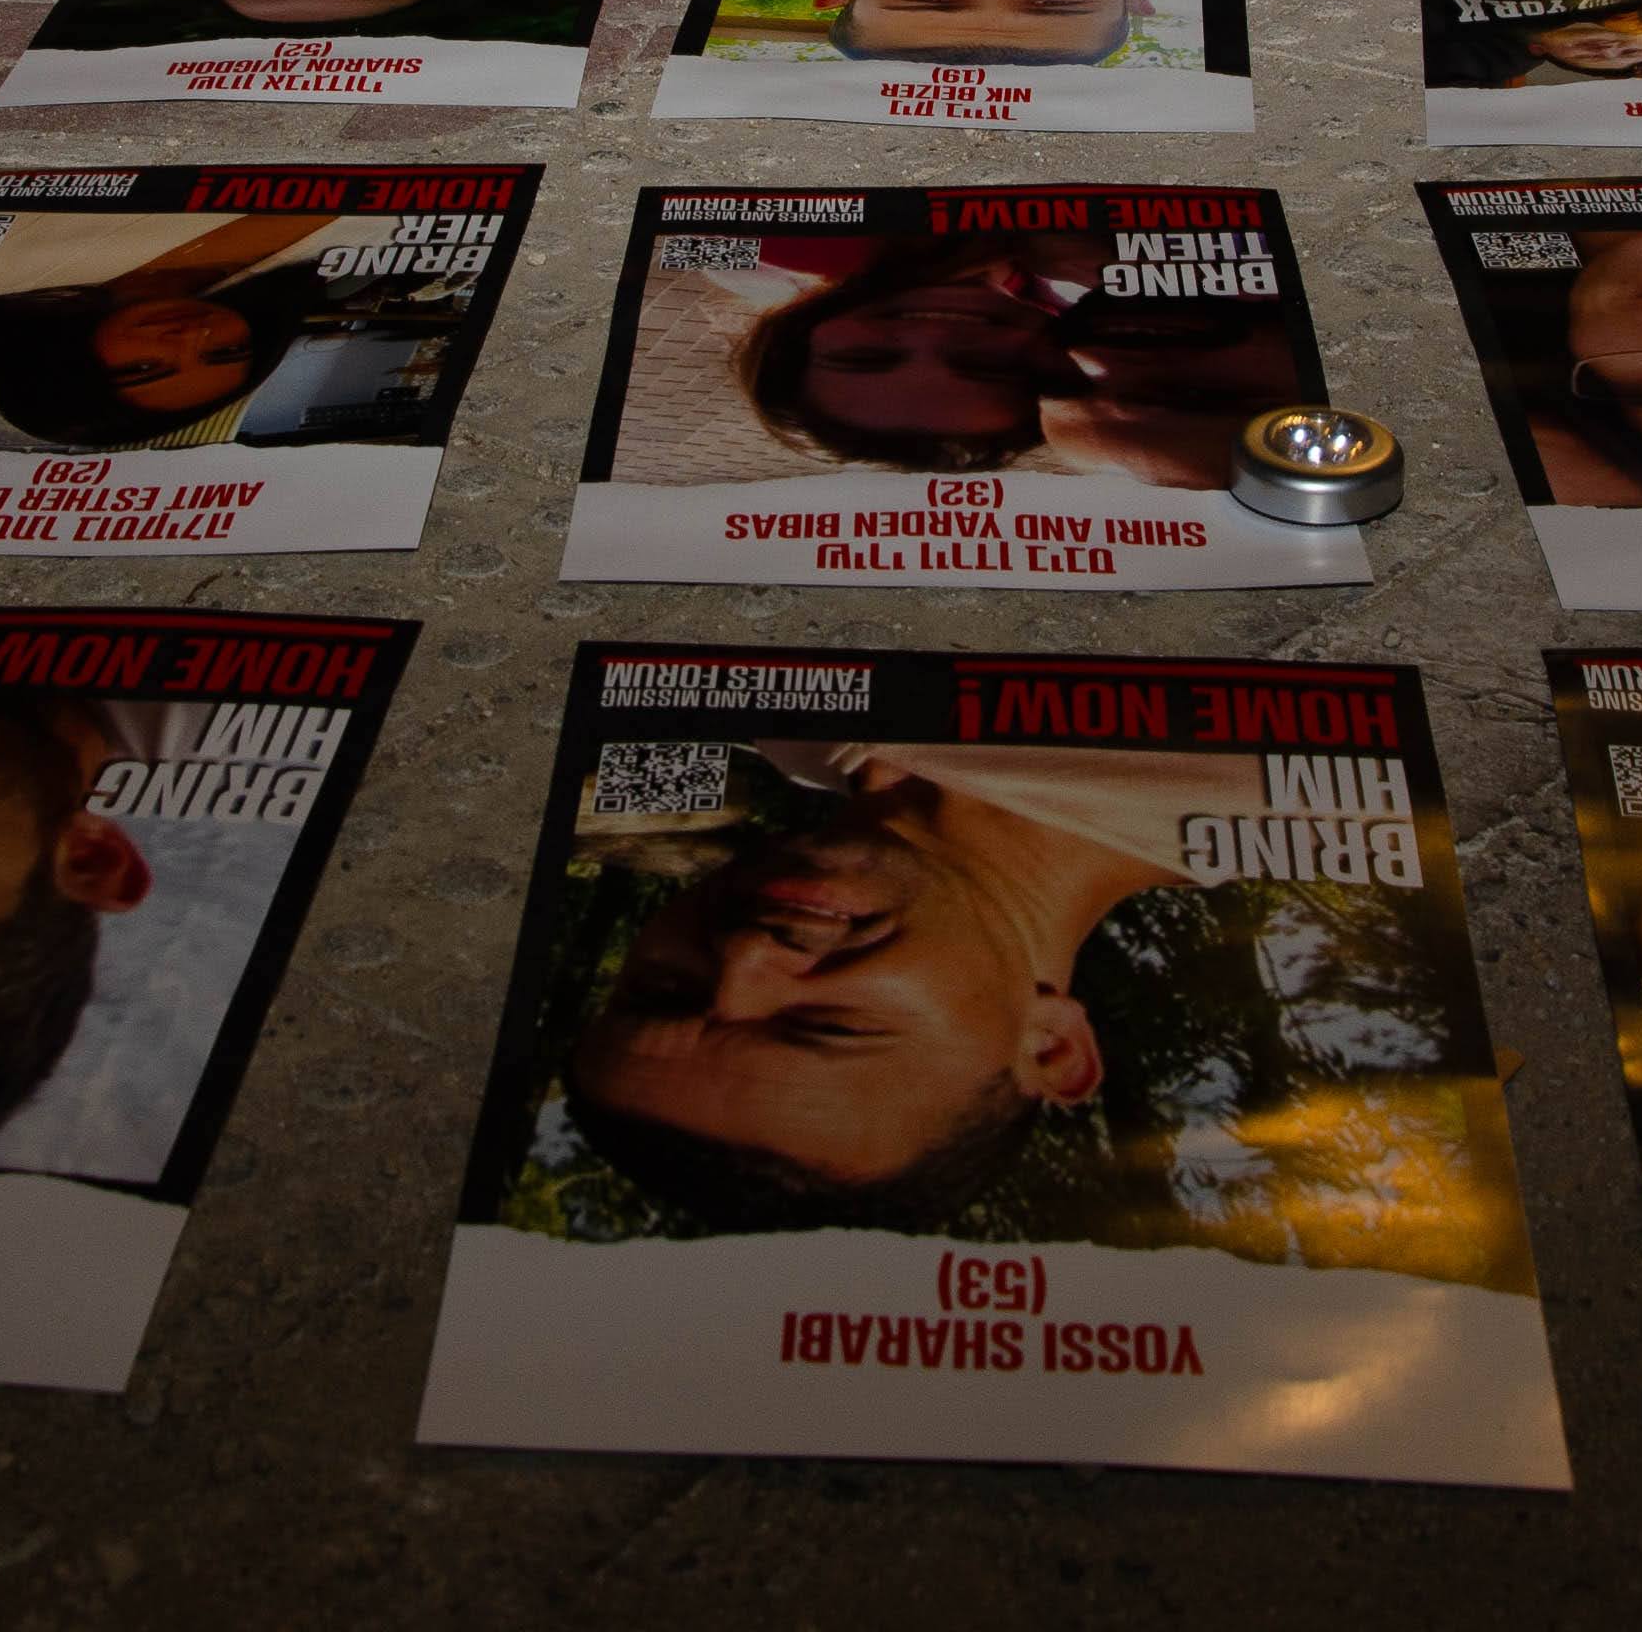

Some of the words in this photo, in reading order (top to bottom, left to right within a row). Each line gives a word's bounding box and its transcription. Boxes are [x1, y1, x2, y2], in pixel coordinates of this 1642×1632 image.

[274, 41, 333, 58] (52)
[165, 58, 300, 76] AVIGDORI
[304, 57, 424, 75] SHARON
[931, 67, 986, 85] (19)
[880, 84, 976, 102] BEIZER
[987, 87, 1033, 103] NIK
[890, 99, 934, 119] ניק
[947, 103, 1017, 120] בייזר
[185, 174, 348, 211] NOW!
[362, 176, 516, 211] HOME
[660, 195, 751, 212] FORUM
[757, 196, 865, 212] FAMILIES
[1447, 187, 1536, 205] FORUM
[660, 210, 733, 223] MISSING
[737, 210, 774, 223] AND
[778, 210, 864, 223] HOSTAGES
[928, 196, 1088, 234] NOW!
[1105, 194, 1261, 230] HOME
[1451, 200, 1529, 216] MISSING
[1532, 200, 1568, 216] AND
[392, 213, 505, 244] HER
[318, 244, 489, 277] BRING
[1116, 231, 1273, 263] THEM
[1102, 262, 1280, 298] BRING
[32, 459, 112, 486] (28)
[21, 487, 155, 510] ESTHER
[165, 483, 263, 510] AMIT
[926, 478, 1006, 509] (32)
[73, 513, 237, 541] בוסקילה
[726, 513, 840, 540] BIBAS
[851, 511, 1005, 540] YARDEN
[1014, 515, 1090, 544] AND
[1105, 519, 1206, 548] SHIRI
[817, 544, 905, 571] שירי
[921, 538, 1012, 573] וירדן
[1026, 546, 1115, 575] ביבס
[166, 636, 375, 694] HOME
[603, 662, 720, 690] FORUM
[725, 665, 872, 692] FAMILIES
[600, 686, 699, 710] MISSING
[703, 687, 751, 711] AND
[754, 689, 871, 712] HOSTAGES
[953, 677, 1167, 740] NOW!
[1191, 682, 1397, 747] HOME
[194, 702, 352, 759] HIM
[86, 760, 326, 824] BRING
[1264, 752, 1410, 813] HIM
[1182, 816, 1422, 889] BRING
[937, 1253, 1047, 1314] (53)
[780, 1314, 1023, 1369] SHARABI
[1044, 1322, 1203, 1375] YOSSI
